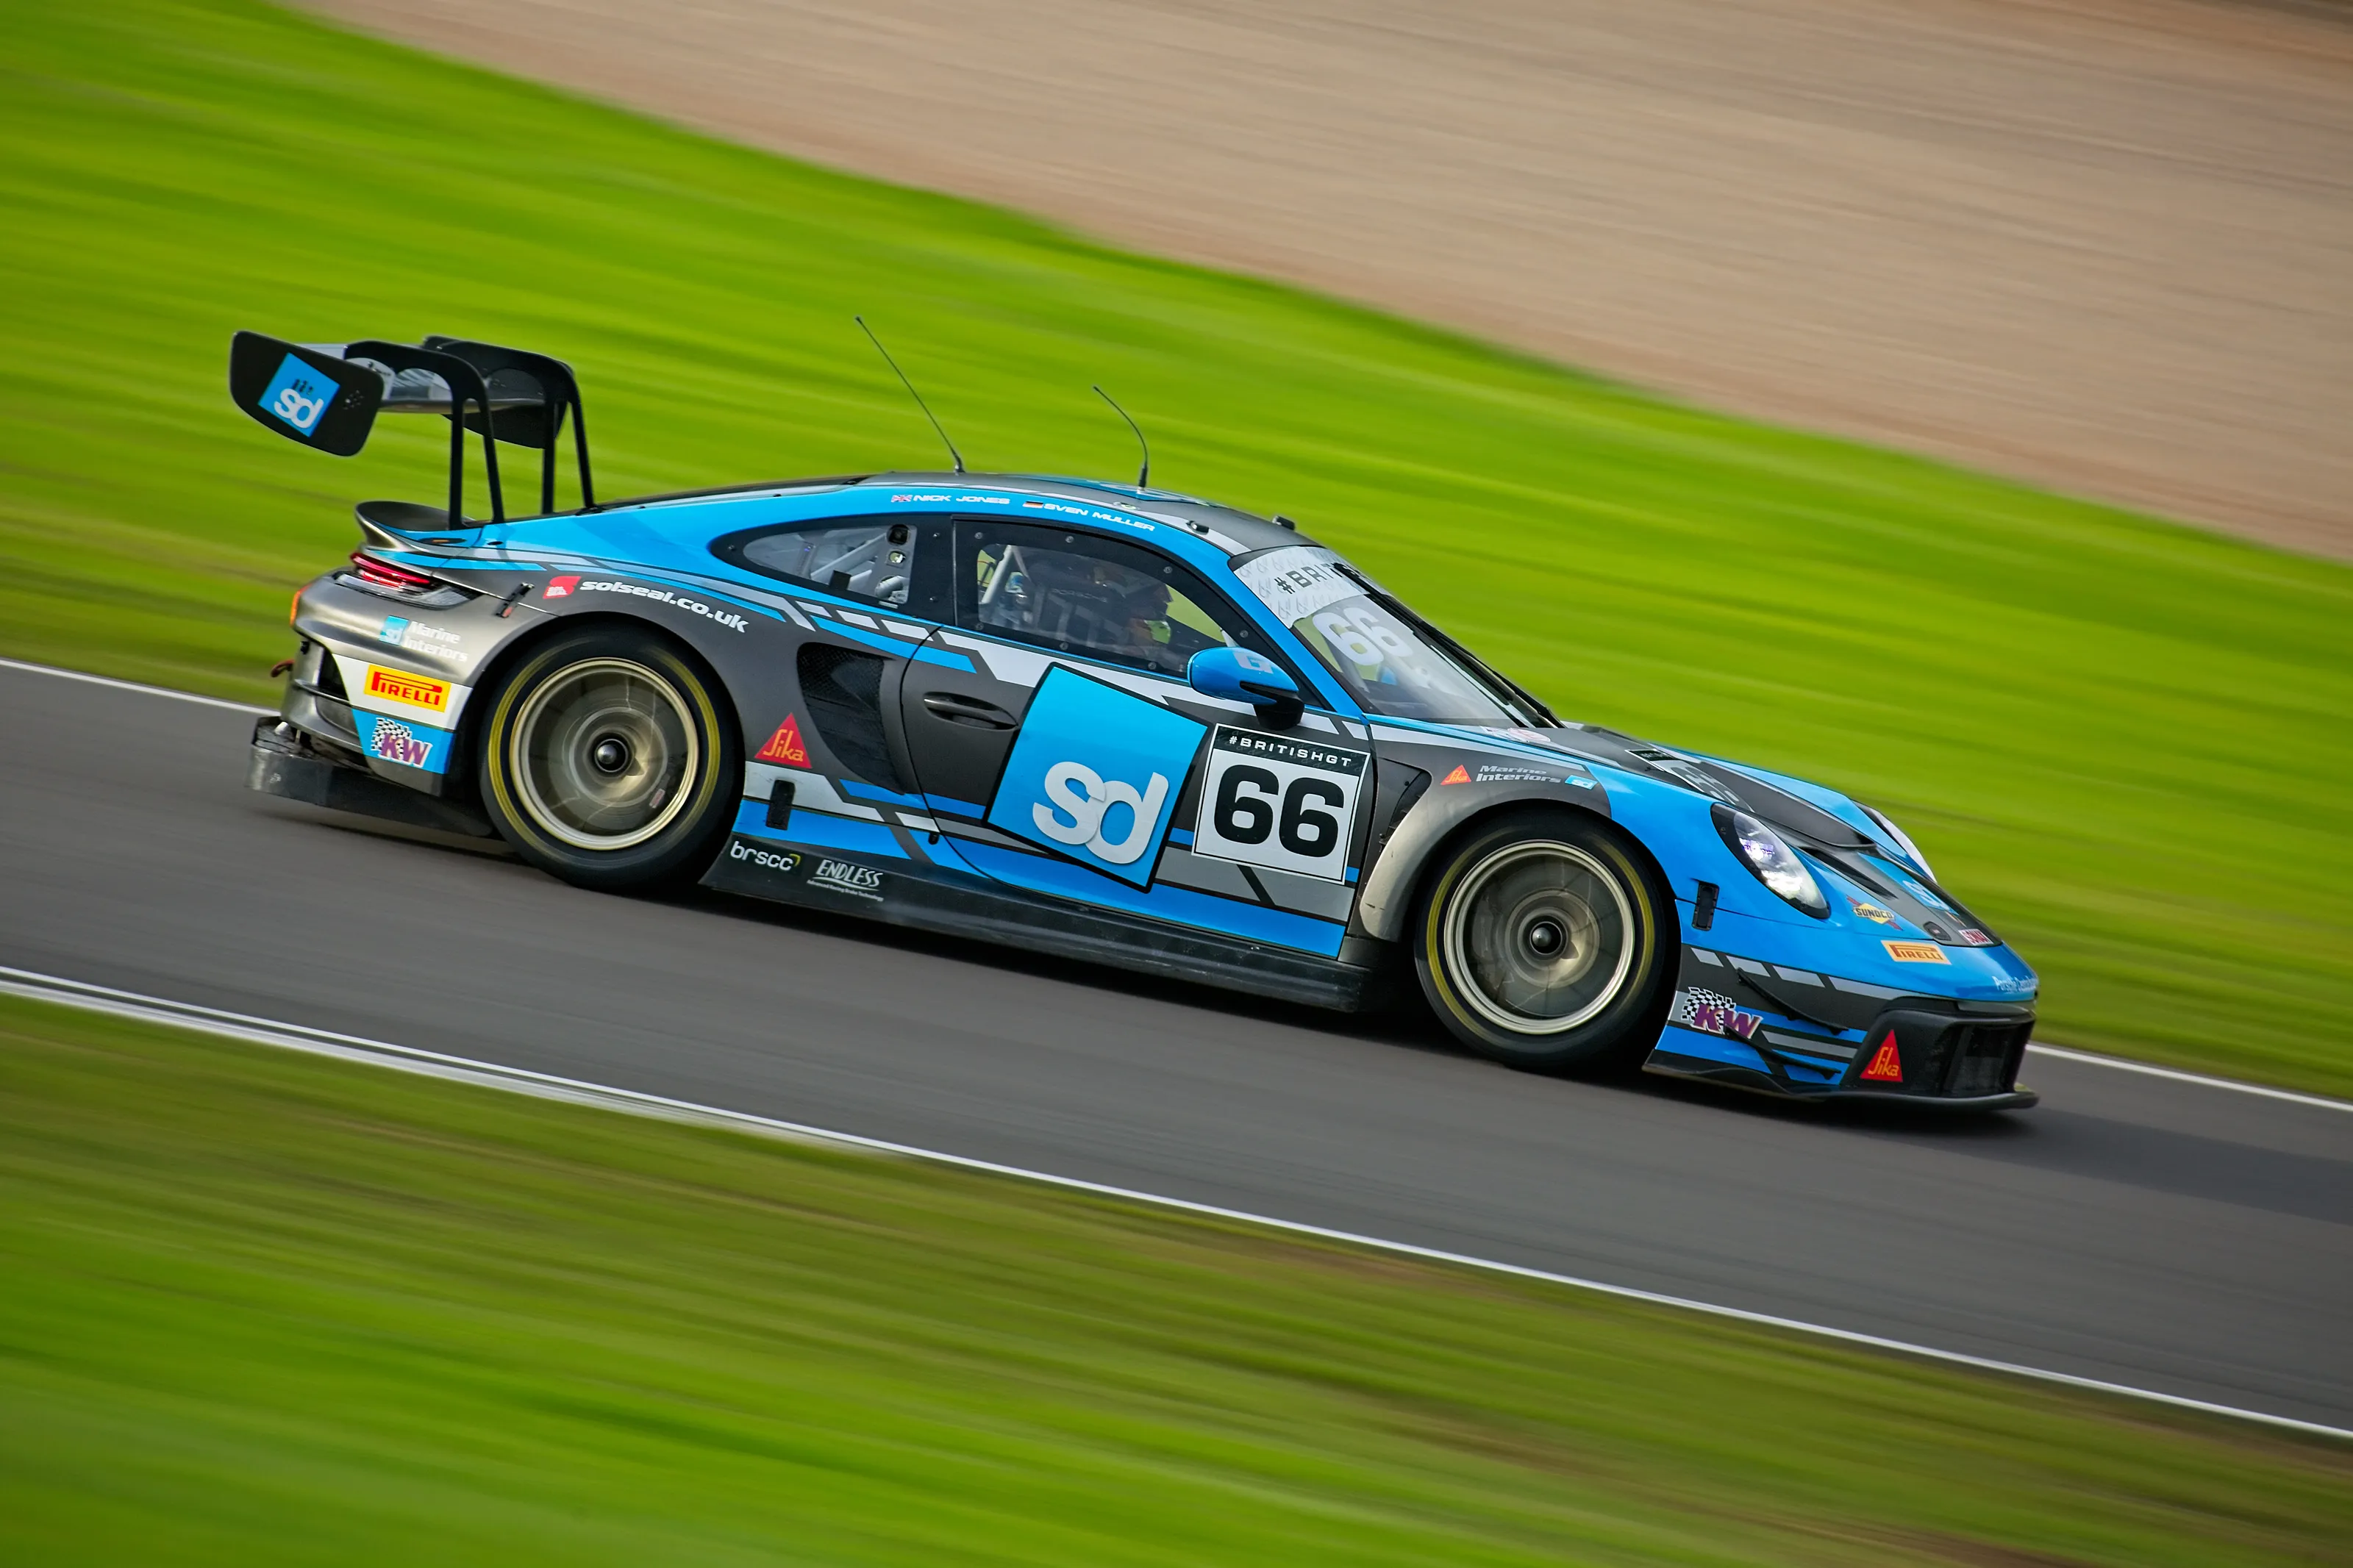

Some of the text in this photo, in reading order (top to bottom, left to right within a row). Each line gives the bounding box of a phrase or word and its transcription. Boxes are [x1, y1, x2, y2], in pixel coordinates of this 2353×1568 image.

[274, 387, 324, 429] sd
[956, 495, 1010, 505] JONES
[1043, 503, 1155, 531] SVEN MULLER
[579, 581, 749, 633] solseal.co.uk
[409, 621, 462, 645] Marine
[1313, 607, 1413, 666] 66
[402, 635, 469, 663] Interiors
[371, 671, 443, 705] PIRELLI
[379, 732, 432, 767] KW
[763, 729, 804, 762] Sika
[1229, 736, 1352, 767] #BRITISHGT
[1476, 773, 1561, 784] Interiors
[1479, 765, 1547, 774] Marine
[1032, 761, 1169, 864] sd
[1213, 765, 1344, 858] 66
[730, 840, 793, 870] brscc
[815, 859, 883, 887] ENDLESS
[1855, 908, 1893, 920] SUNOCO
[1889, 944, 1944, 960] PIRELLI
[1692, 1003, 1763, 1039] KW
[1868, 1046, 1899, 1076] Sika
